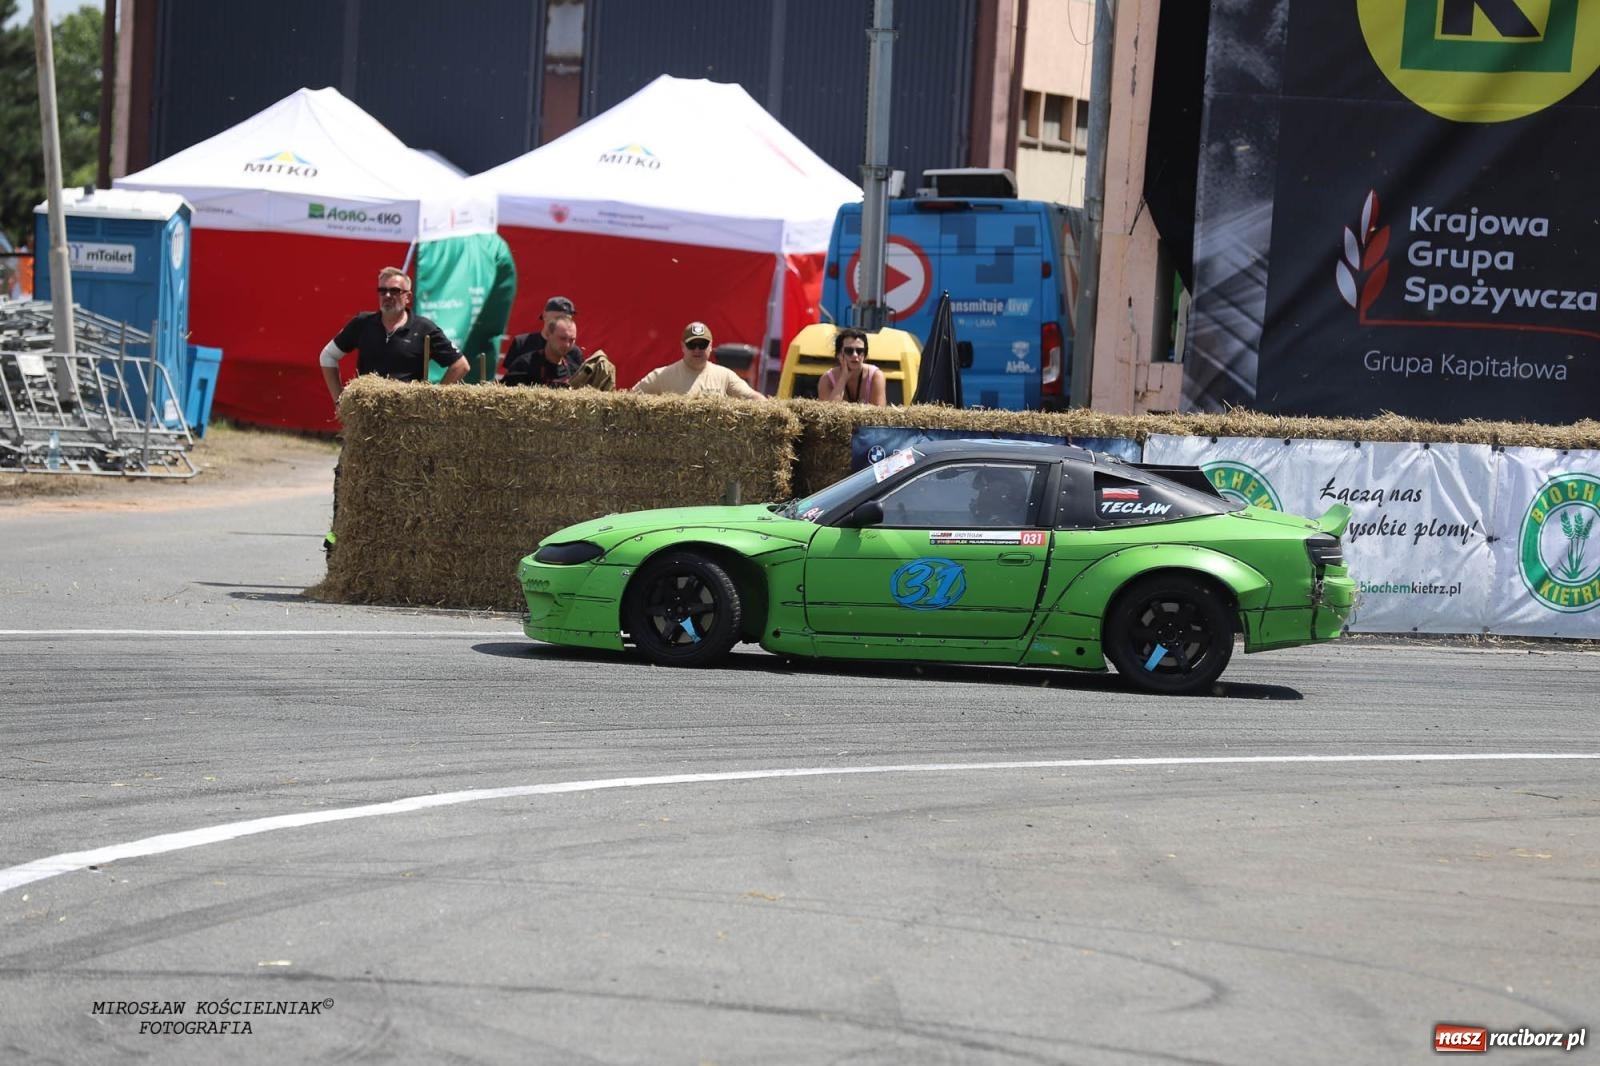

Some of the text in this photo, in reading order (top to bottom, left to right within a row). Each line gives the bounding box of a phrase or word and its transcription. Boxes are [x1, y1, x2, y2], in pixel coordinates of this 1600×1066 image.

[243, 162, 318, 177] MITKO
[599, 153, 661, 169] MITKO
[1408, 206, 1549, 243] Krajowa
[86, 248, 133, 264] mToilet
[1407, 241, 1515, 275] Grupa
[950, 298, 1004, 316] ansmituje
[1404, 276, 1598, 314] Spożywcza
[1363, 350, 1567, 381] Grupa Kapitałowa
[1214, 469, 1273, 510] CHEM
[1320, 477, 1422, 507] Łączą nas
[1531, 480, 1600, 525] BIOCH
[1100, 502, 1172, 515] TECŁAW
[1022, 533, 1042, 545] 031
[1344, 514, 1479, 545] ysokie plony!
[896, 564, 964, 604] 31
[1360, 581, 1462, 597] biochemkietrz.pl
